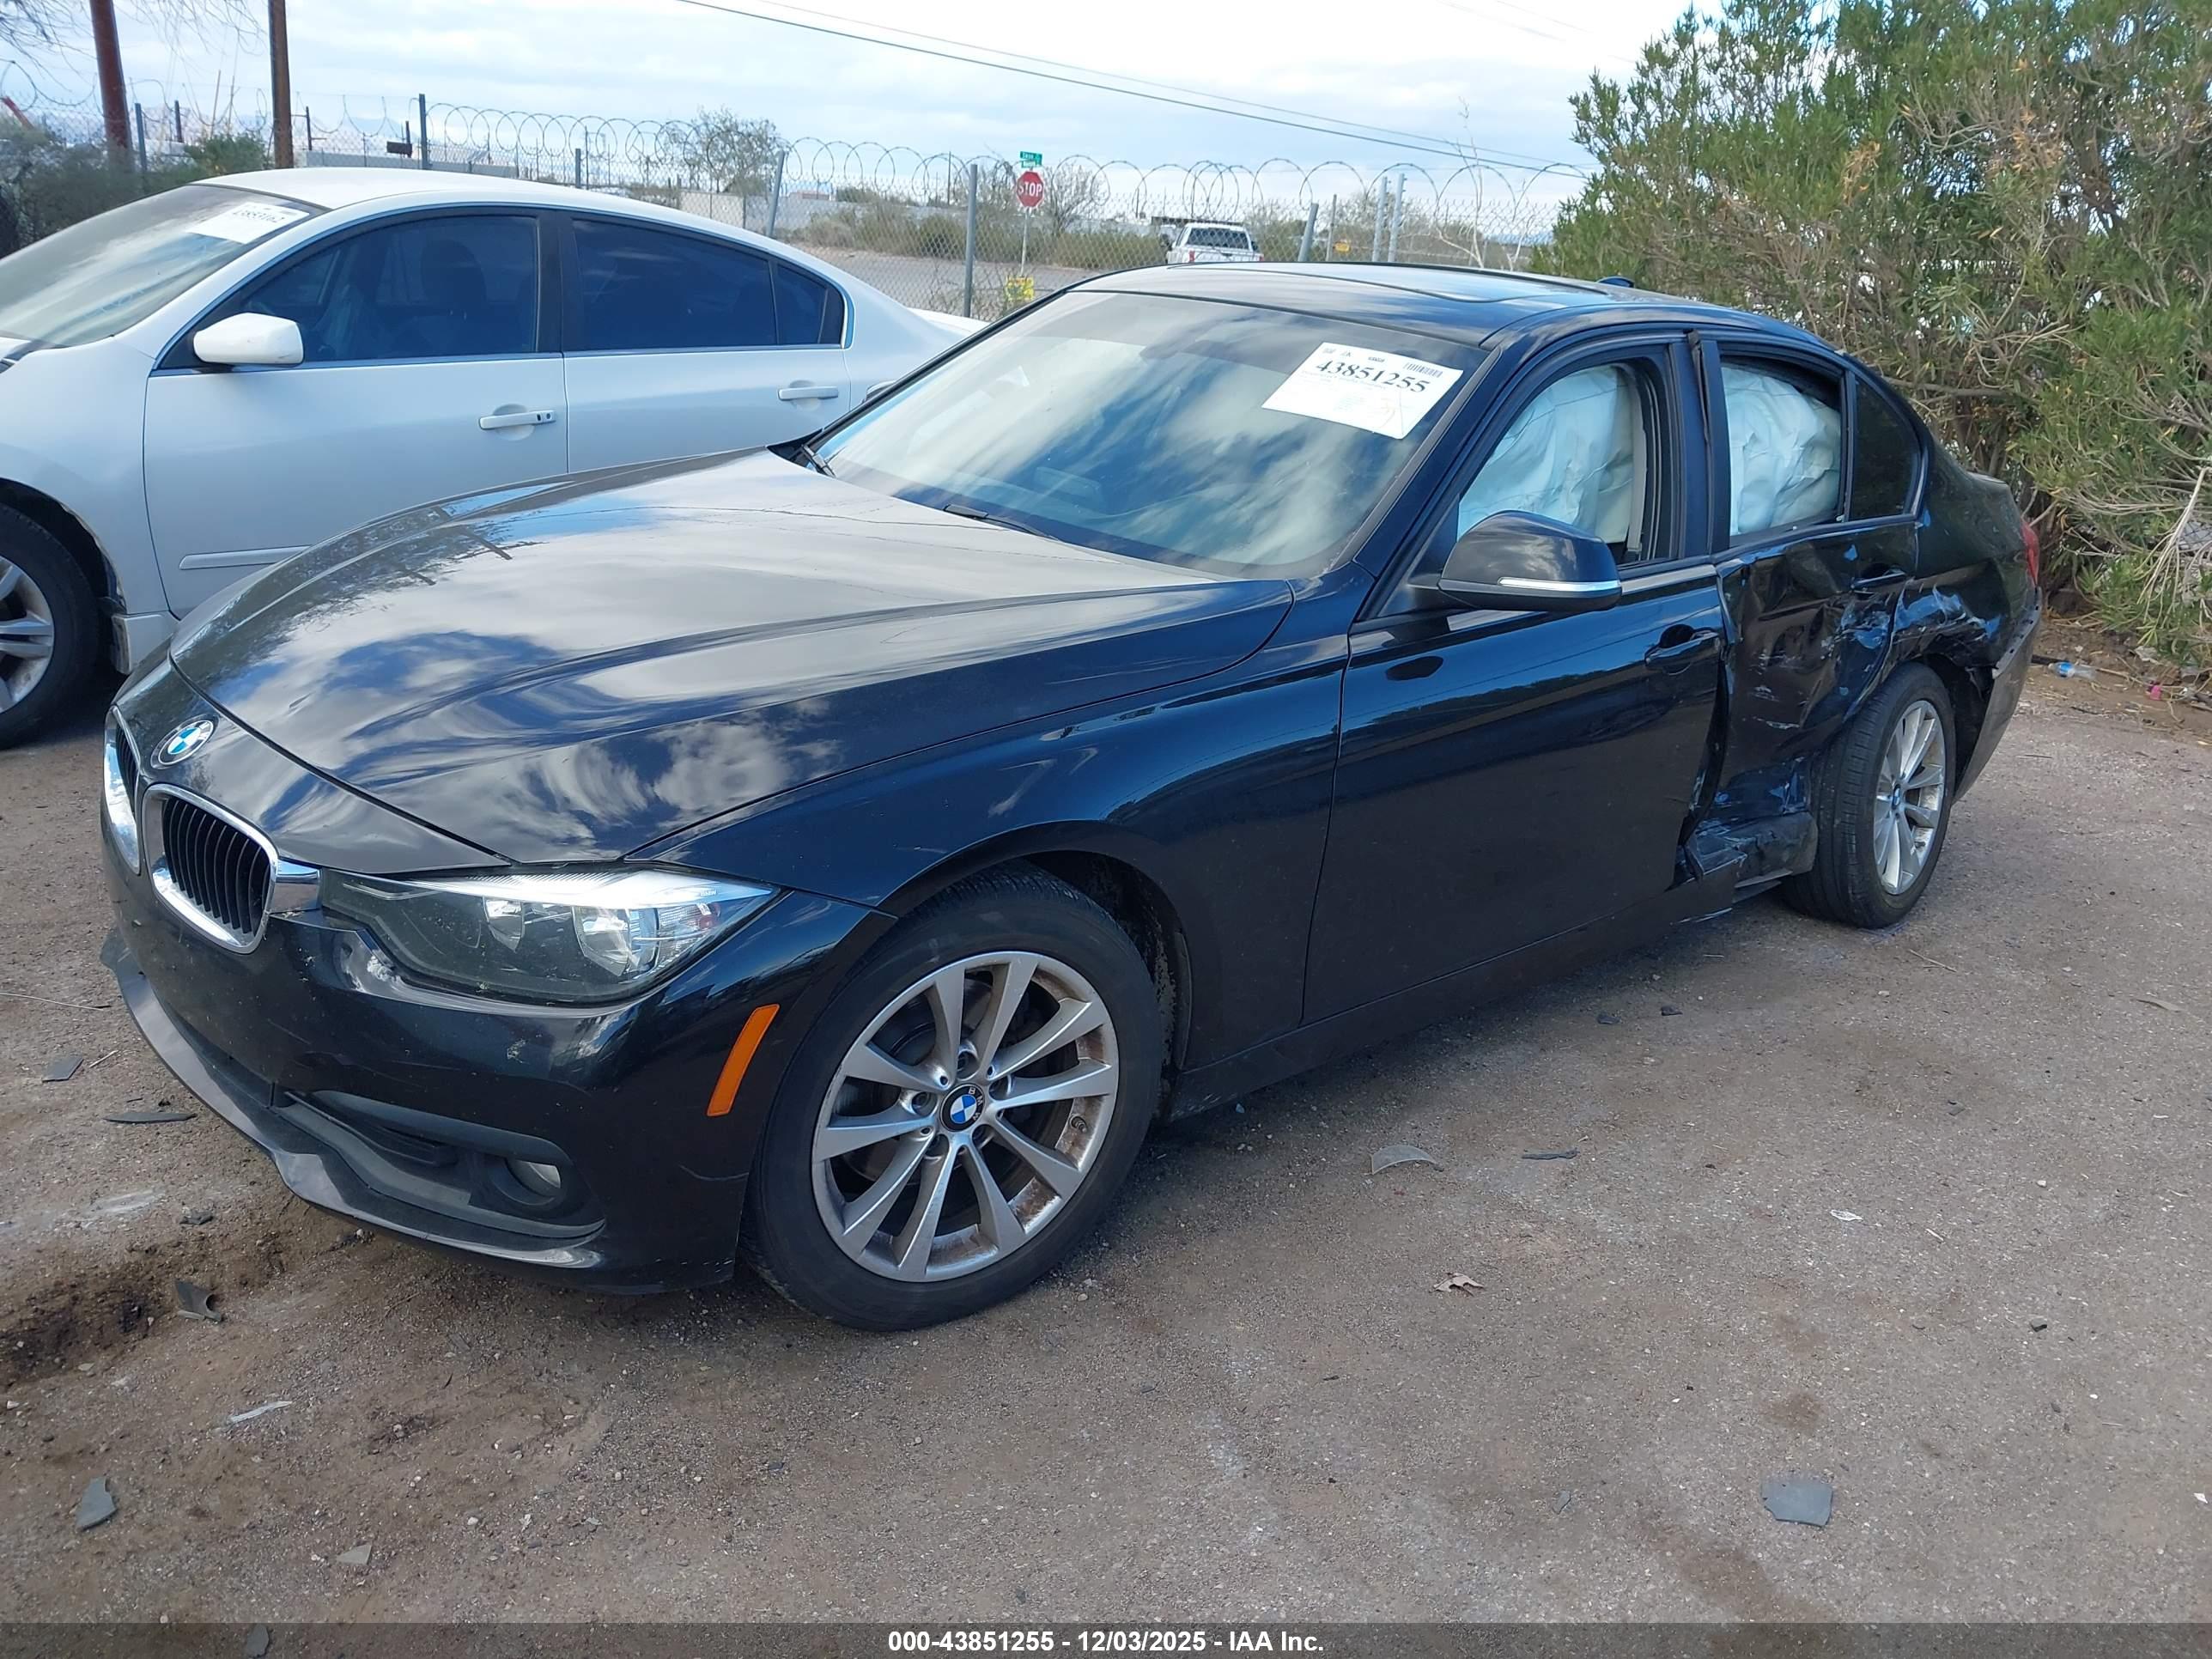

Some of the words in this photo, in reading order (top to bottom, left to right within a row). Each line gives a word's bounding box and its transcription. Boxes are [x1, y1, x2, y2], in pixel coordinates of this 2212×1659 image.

[1018, 181, 1042, 197] STOP
[1316, 359, 1431, 392] 43851255
[968, 1086, 983, 1121] BMW
